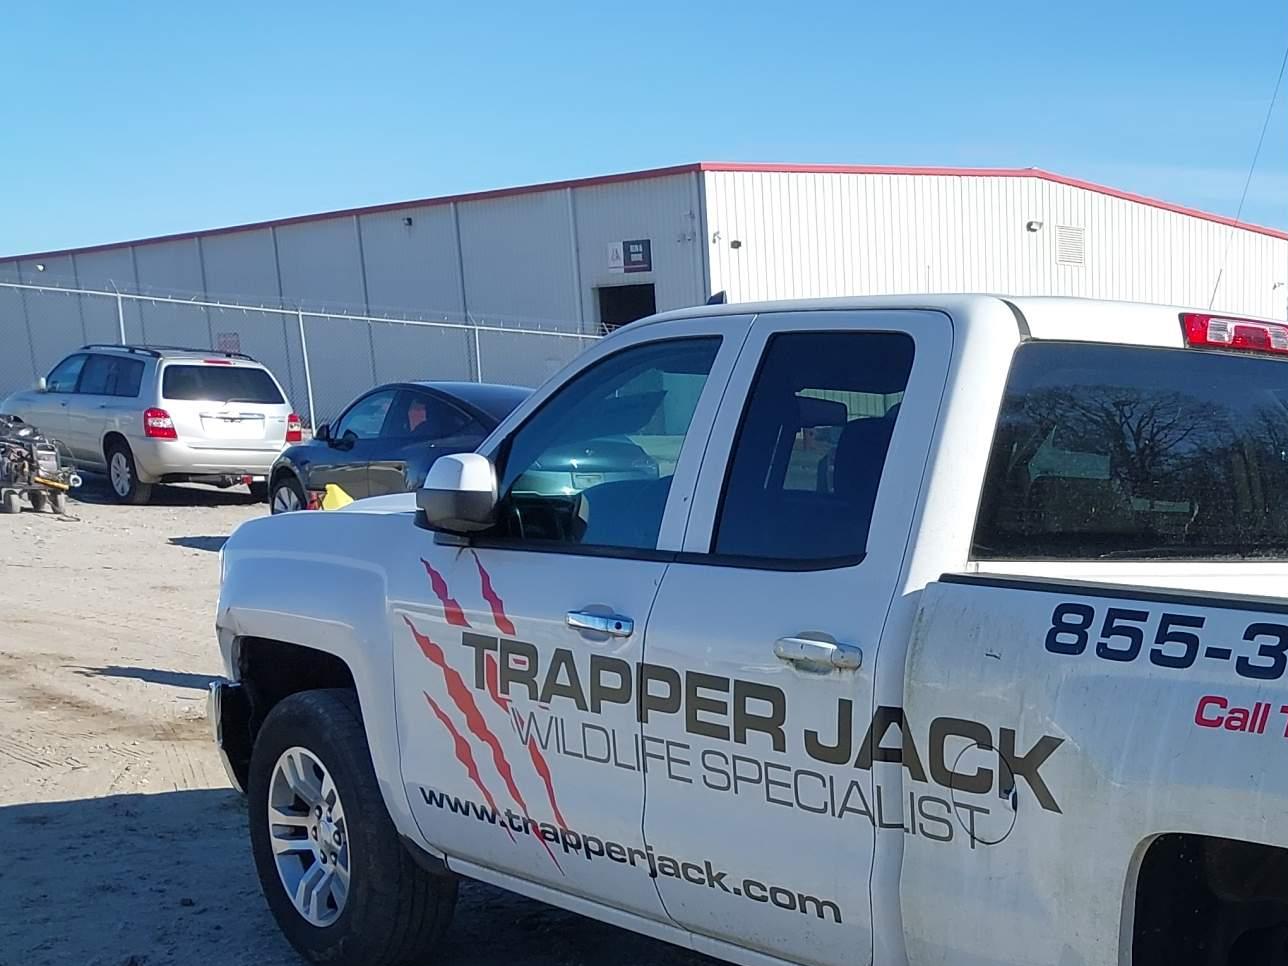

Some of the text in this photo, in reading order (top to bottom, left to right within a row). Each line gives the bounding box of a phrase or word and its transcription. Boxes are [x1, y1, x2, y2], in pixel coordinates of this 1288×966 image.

[461, 631, 1065, 815] TRAPPER JACK
[510, 706, 990, 851] WILDLIFE SPECIALIST
[1194, 695, 1270, 734] Call
[418, 785, 843, 924] www.trapperjack.com
